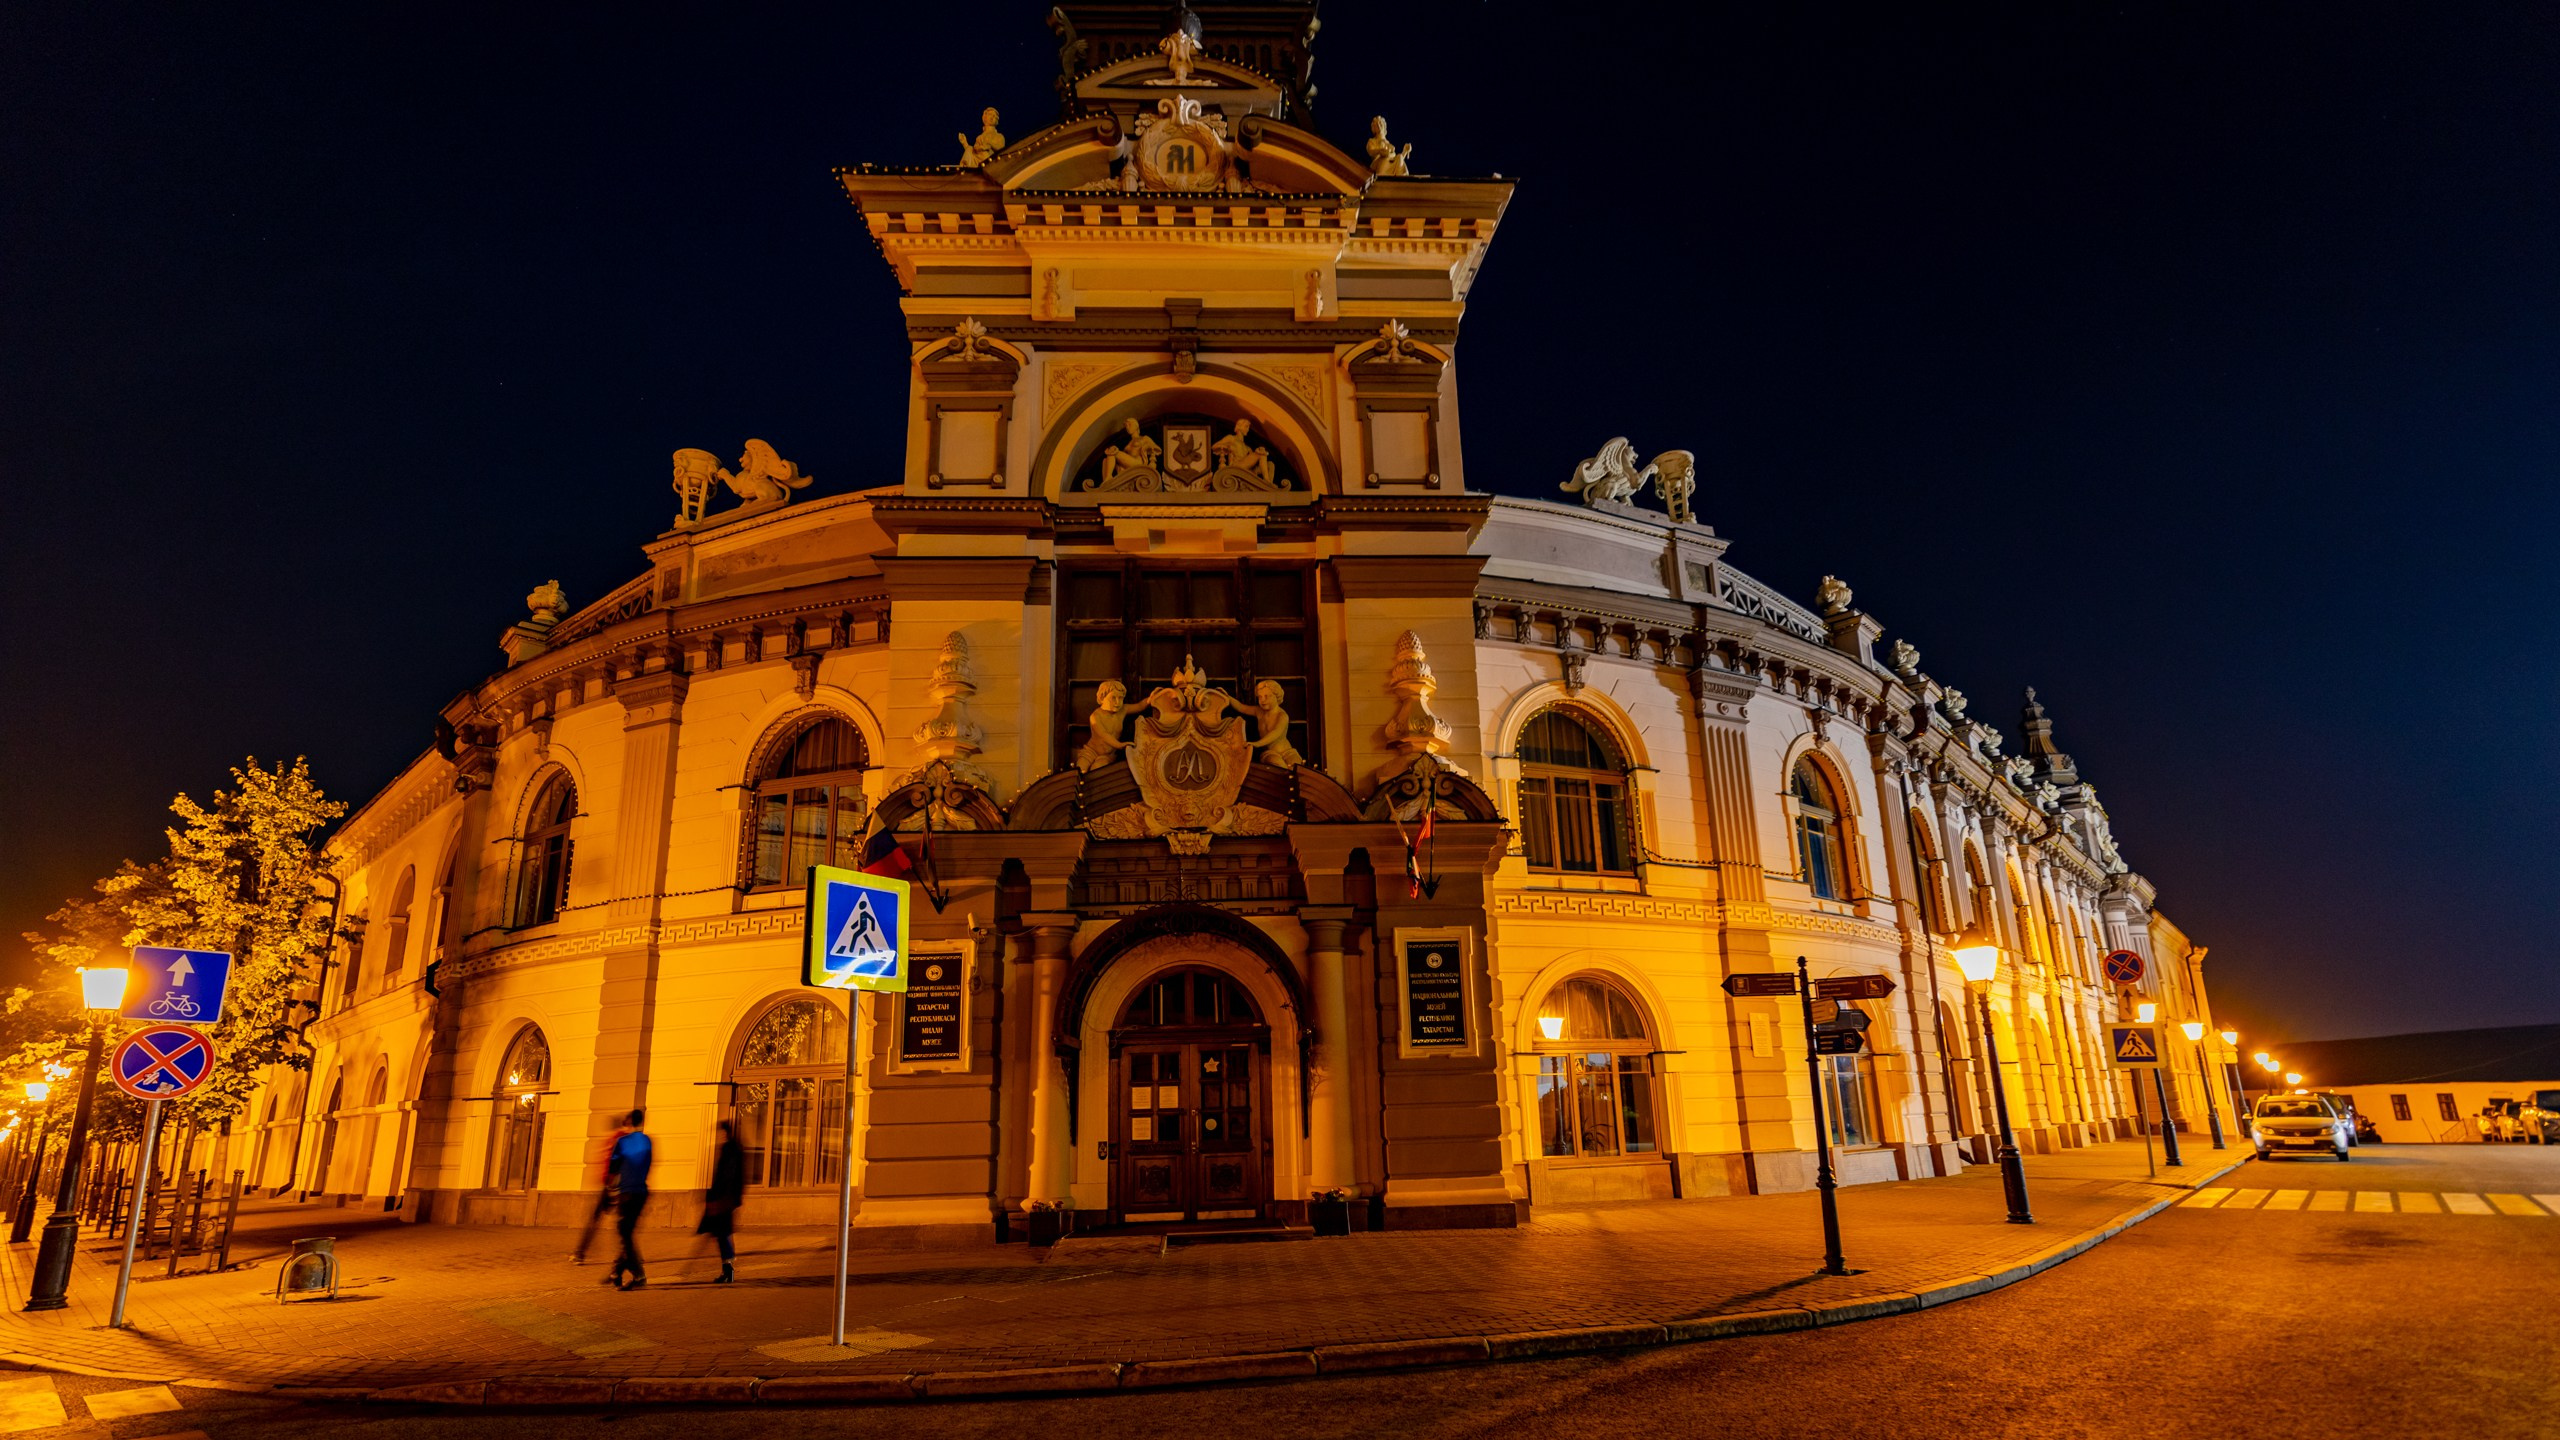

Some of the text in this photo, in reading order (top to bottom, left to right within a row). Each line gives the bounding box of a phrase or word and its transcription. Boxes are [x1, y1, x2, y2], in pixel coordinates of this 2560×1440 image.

[1412, 991, 1459, 1000] НАЦИОНАЛЬНЫЙ
[1426, 1002, 1446, 1010] МУЗЕЙ
[910, 1014, 956, 1022] РЕСПУБЛИКАСЫ
